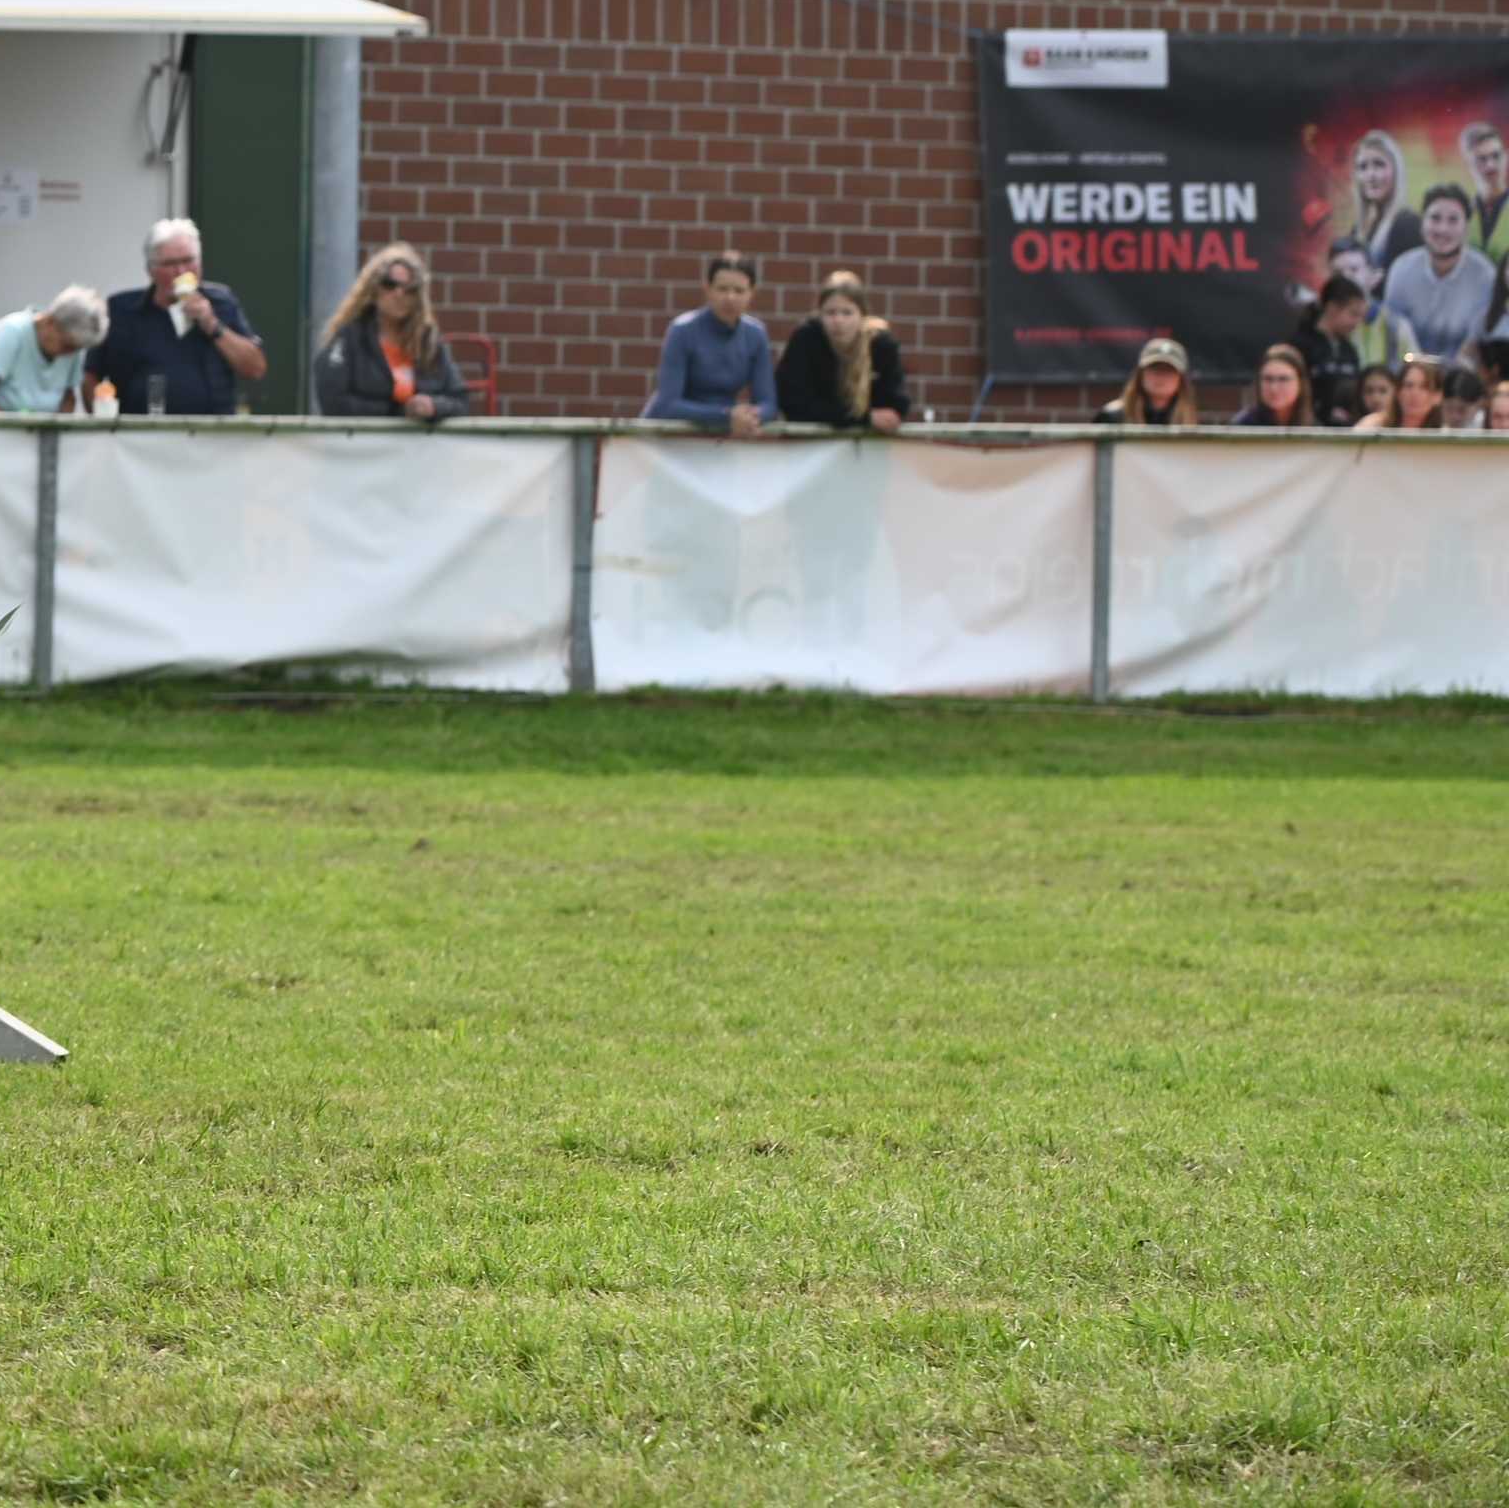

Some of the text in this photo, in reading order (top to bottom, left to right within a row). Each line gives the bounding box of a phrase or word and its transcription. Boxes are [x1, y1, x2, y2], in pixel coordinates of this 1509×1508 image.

[1006, 182, 1258, 223] WERDE EIN
[1012, 230, 1260, 273] ORIGINAL
